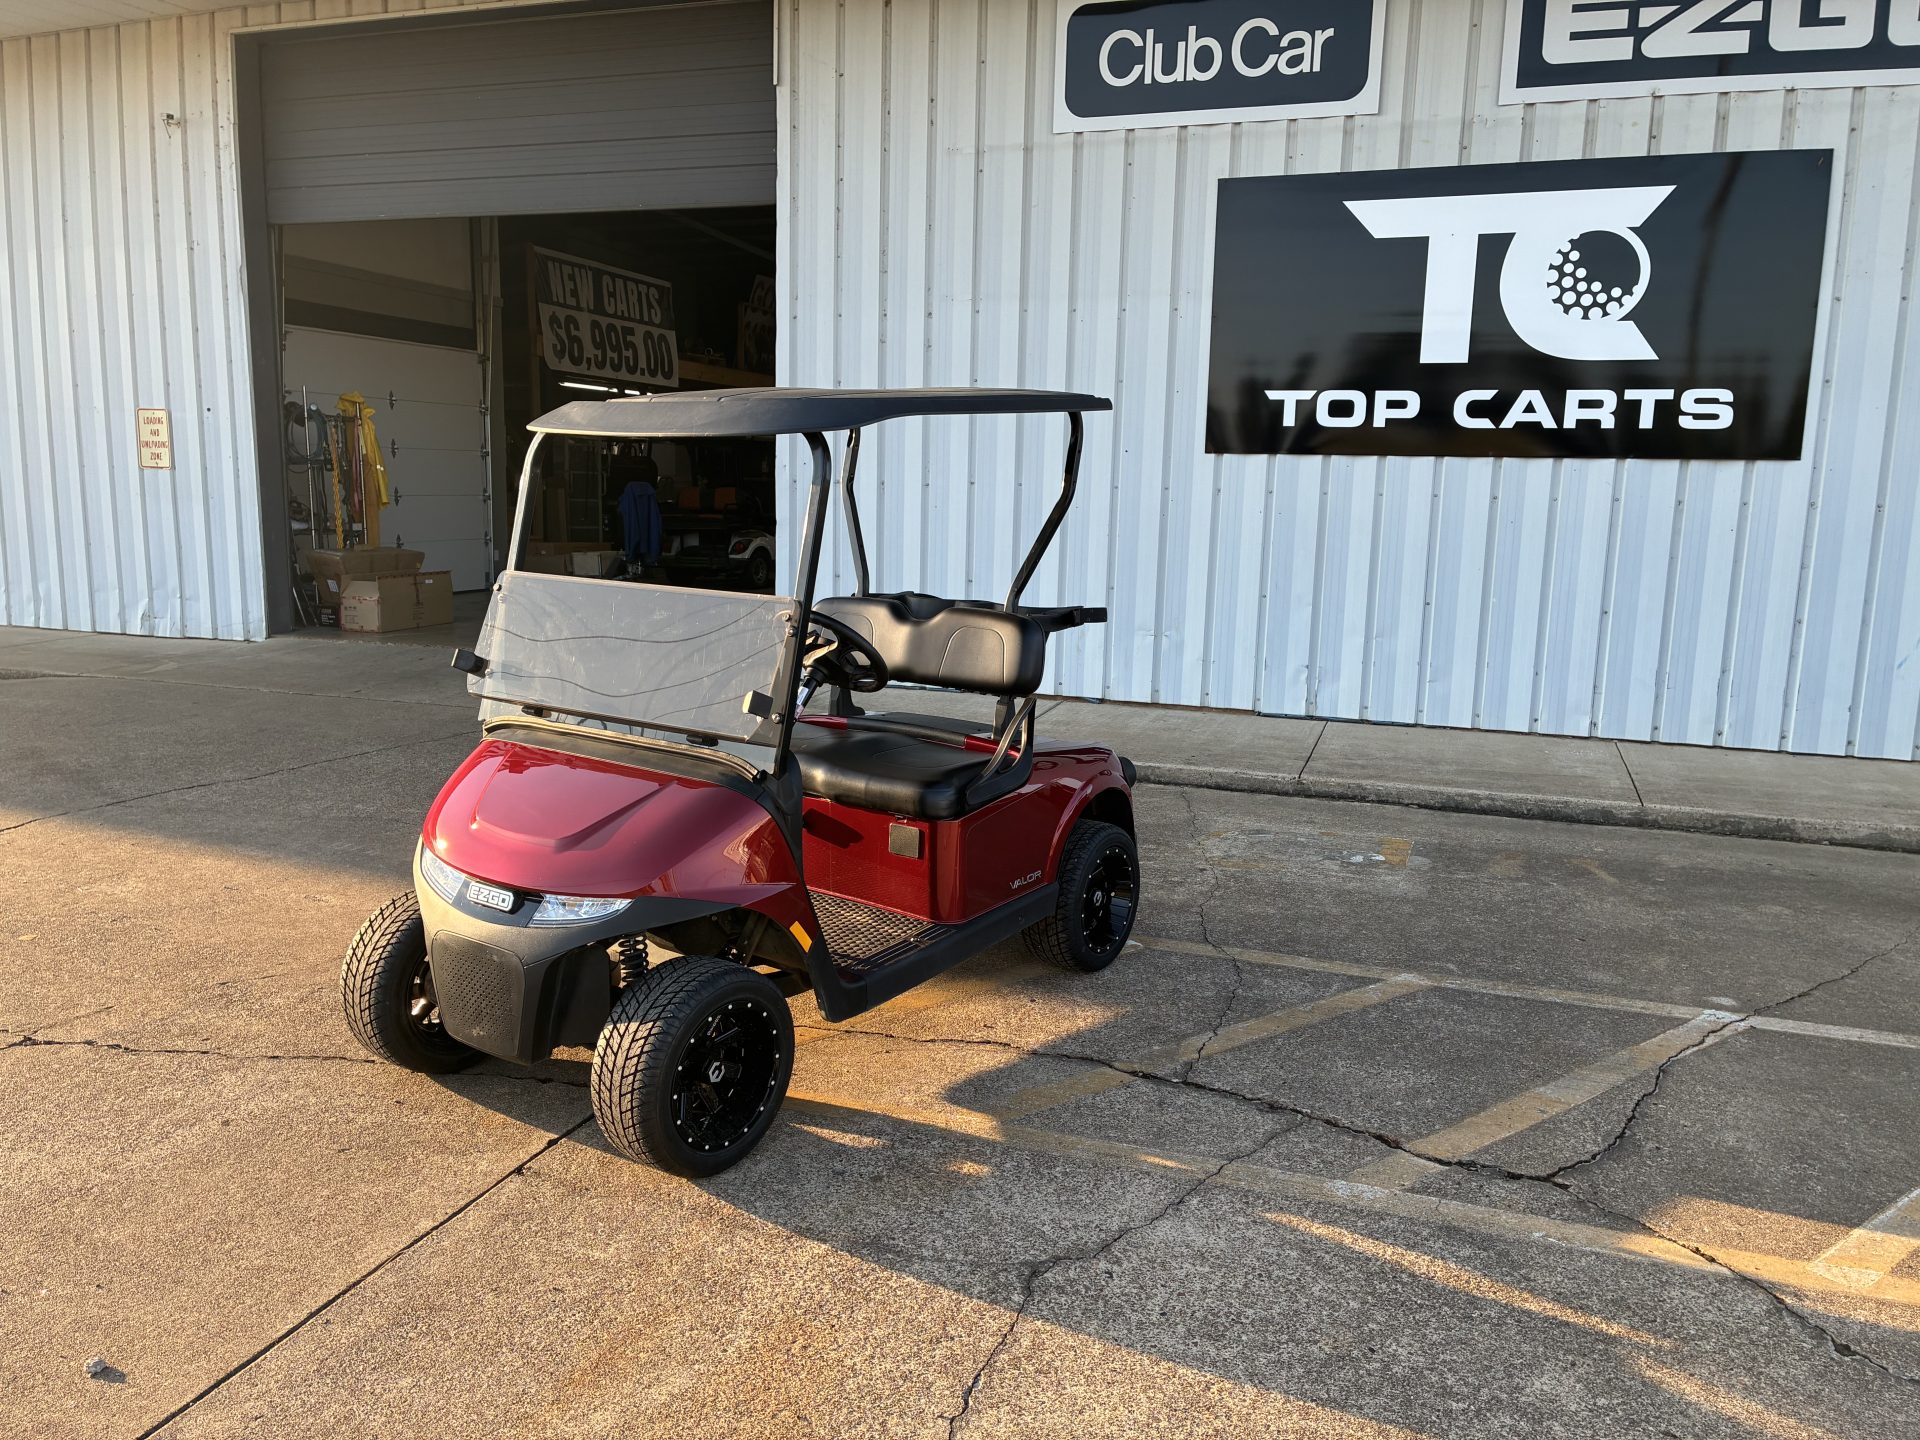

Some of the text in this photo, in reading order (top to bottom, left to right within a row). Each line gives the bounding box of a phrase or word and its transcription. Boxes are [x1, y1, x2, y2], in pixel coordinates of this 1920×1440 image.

[1099, 17, 1335, 87] Club Car
[547, 259, 662, 325] NEW CARTS
[548, 311, 674, 381] $6,995.00
[1264, 388, 1735, 430] TOP CARTS
[143, 416, 163, 424] LOADING
[150, 428, 160, 436] AND
[141, 440, 168, 448] UNLOADING
[150, 452, 162, 460] ZONE
[1010, 870, 1042, 889] VALOR
[470, 886, 511, 908] EZGO
